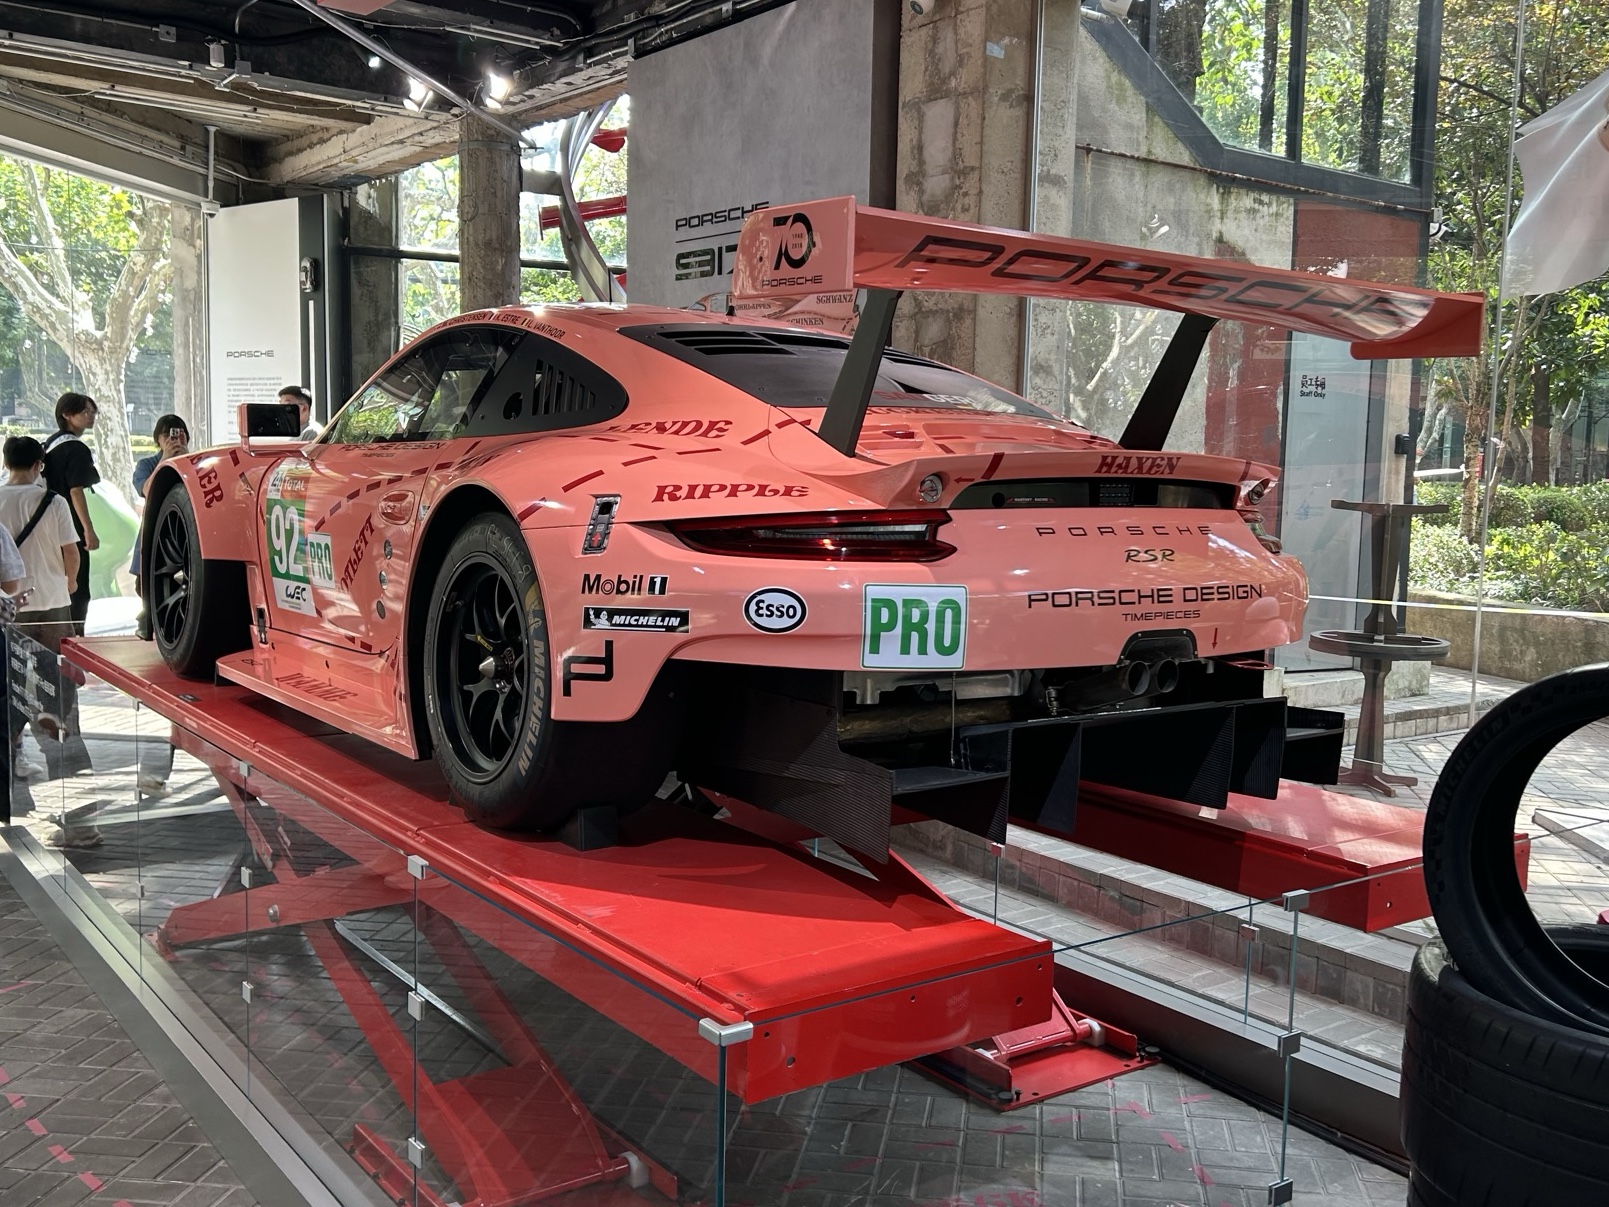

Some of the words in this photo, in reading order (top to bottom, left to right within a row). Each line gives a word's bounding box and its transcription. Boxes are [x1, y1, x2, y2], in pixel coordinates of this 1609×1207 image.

[761, 275, 823, 288] PORSCHE
[893, 234, 1415, 320] PORSCHE
[816, 293, 854, 304] SCHWANZ
[533, 320, 566, 340] VANTHOOR
[226, 350, 275, 358] PORSCHE
[1313, 391, 1326, 399] Only
[1094, 455, 1181, 475] HAXEN
[283, 476, 306, 491] TOTAL
[270, 504, 304, 577] 92
[1035, 526, 1212, 537] PORSCHE
[308, 540, 333, 581] PRO
[1124, 548, 1175, 563] RSR
[581, 573, 644, 595] Mobil
[285, 585, 307, 602] WEC
[1027, 587, 1174, 609] PORSCHE
[1182, 584, 1262, 603] DESIGN
[754, 598, 798, 620] Esso
[1121, 610, 1201, 622] TIMEPIECES
[611, 615, 681, 626] MICHELIN
[868, 597, 962, 656] PRO
[518, 639, 546, 777] MICHELIN
